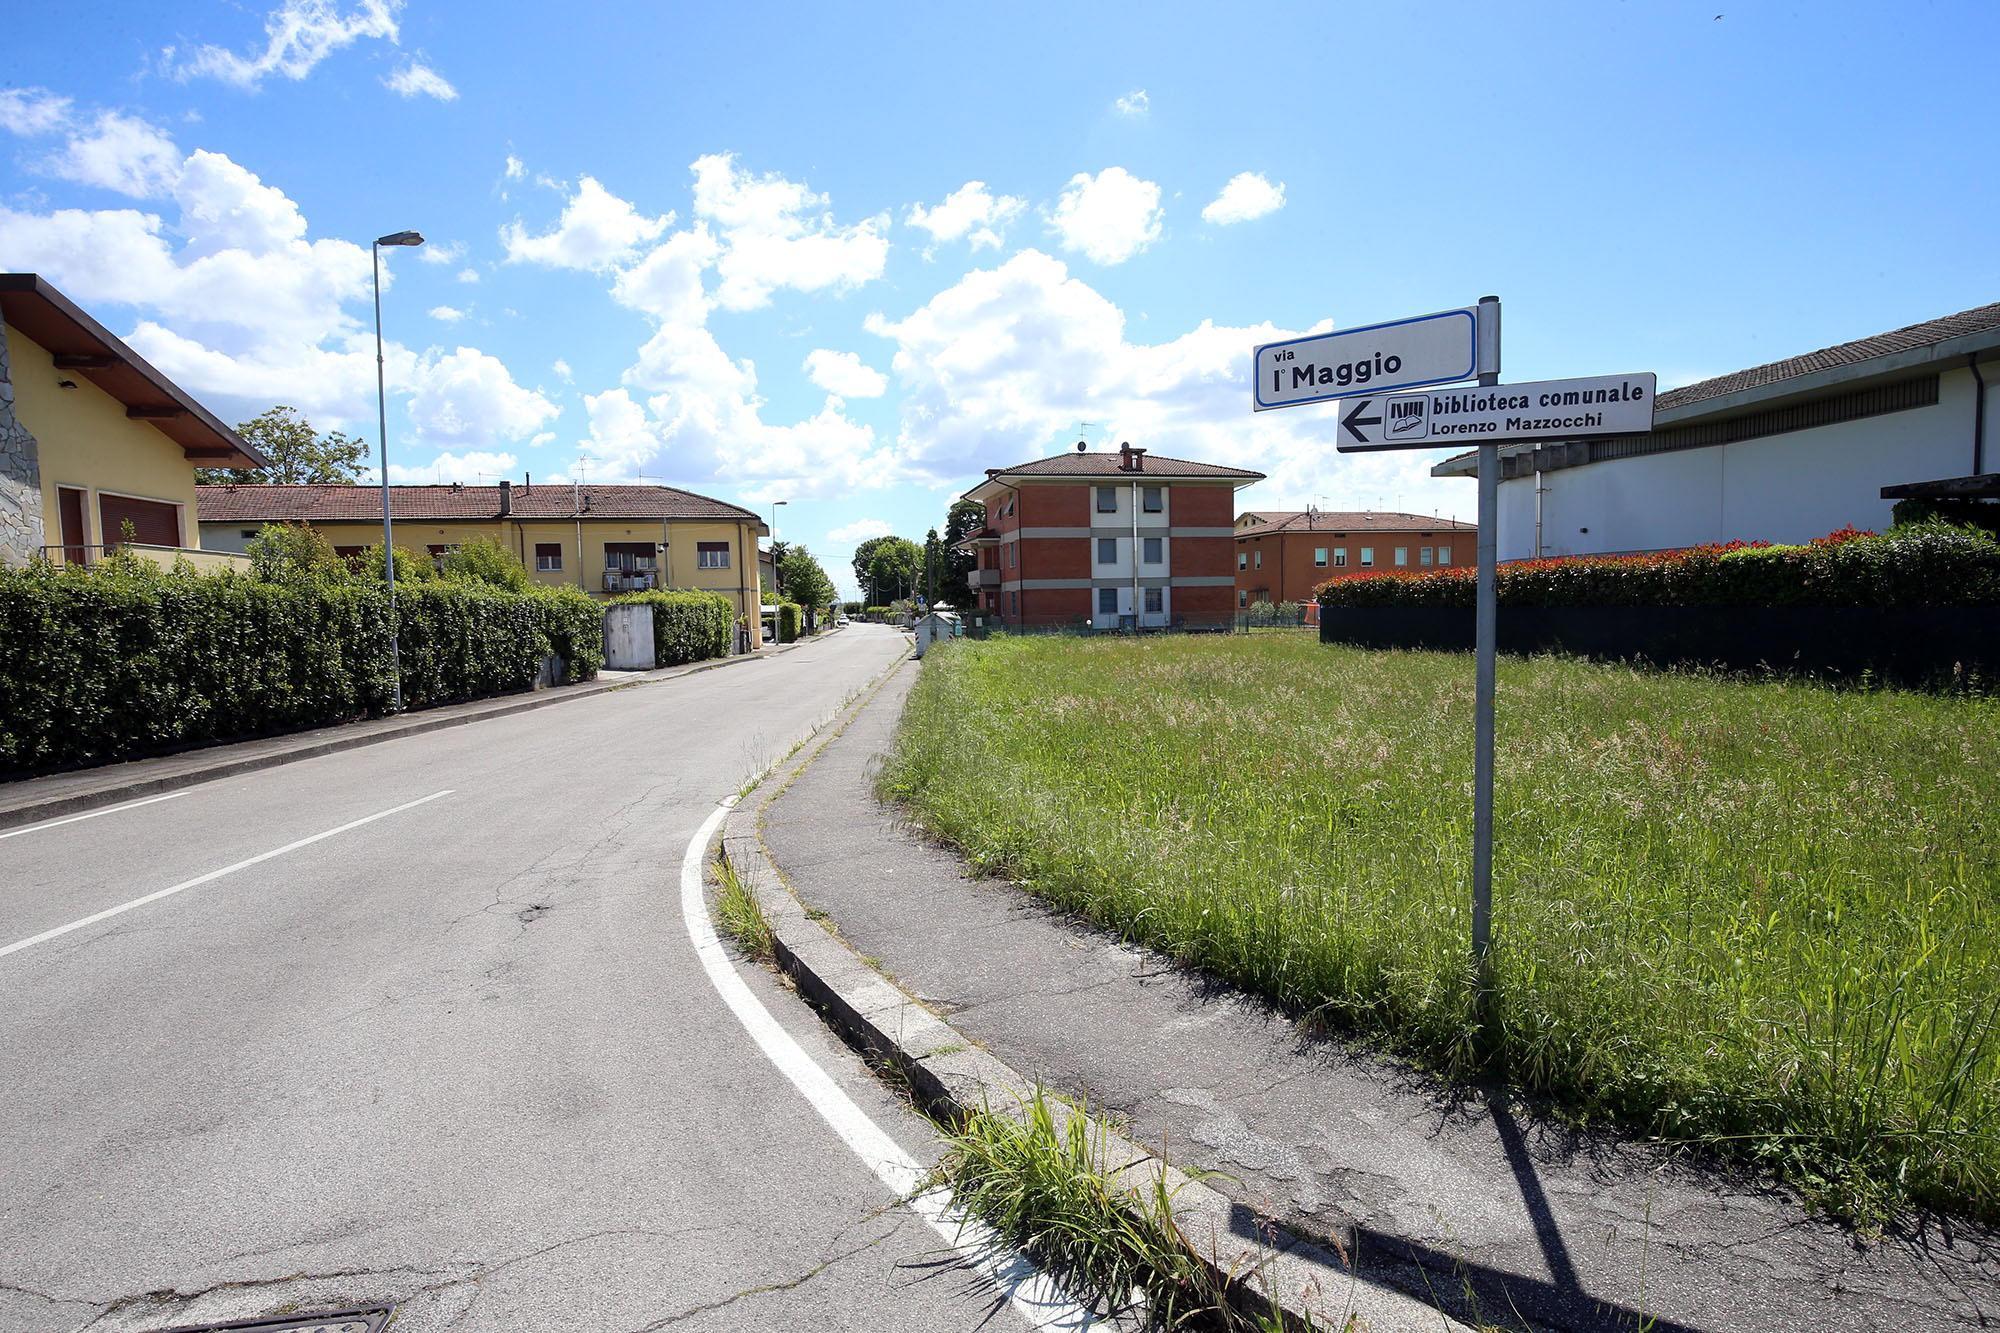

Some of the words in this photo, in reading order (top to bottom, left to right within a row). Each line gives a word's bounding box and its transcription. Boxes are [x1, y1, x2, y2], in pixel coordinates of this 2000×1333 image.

[1274, 349, 1296, 363] via
[1292, 351, 1402, 389] Maggio
[1432, 392, 1530, 416] biblioteca
[1538, 381, 1644, 408] comunale
[1431, 421, 1498, 436] Lorenzo
[1505, 412, 1603, 432] Mazzocchi
